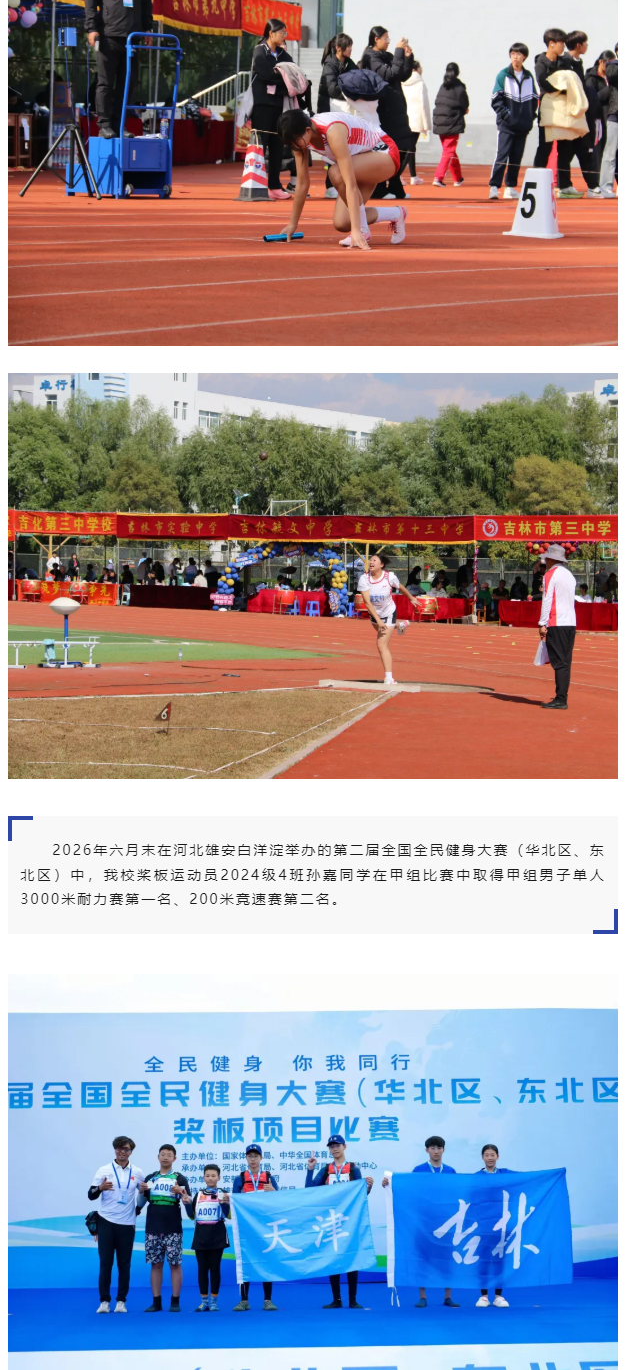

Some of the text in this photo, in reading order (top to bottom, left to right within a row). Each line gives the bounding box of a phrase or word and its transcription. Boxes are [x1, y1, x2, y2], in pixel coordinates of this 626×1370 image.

[521, 182, 537, 219] 5
[600, 384, 618, 397] 卓
[18, 515, 112, 532] 吉化第三中学校
[128, 520, 218, 535] 吉林市实验中学
[240, 519, 334, 536] 吉林毓文中学
[354, 521, 465, 536] 吉林市第十三中学
[503, 520, 612, 536] 吉林市第三中学
[161, 708, 169, 720] 6
[144, 1054, 411, 1073] 全民健身 你我同行
[173, 1116, 400, 1144] 桨板项目比赛
[198, 1208, 217, 1216] A007
[262, 1208, 350, 1254] 天津
[433, 1189, 540, 1270] 吉林
